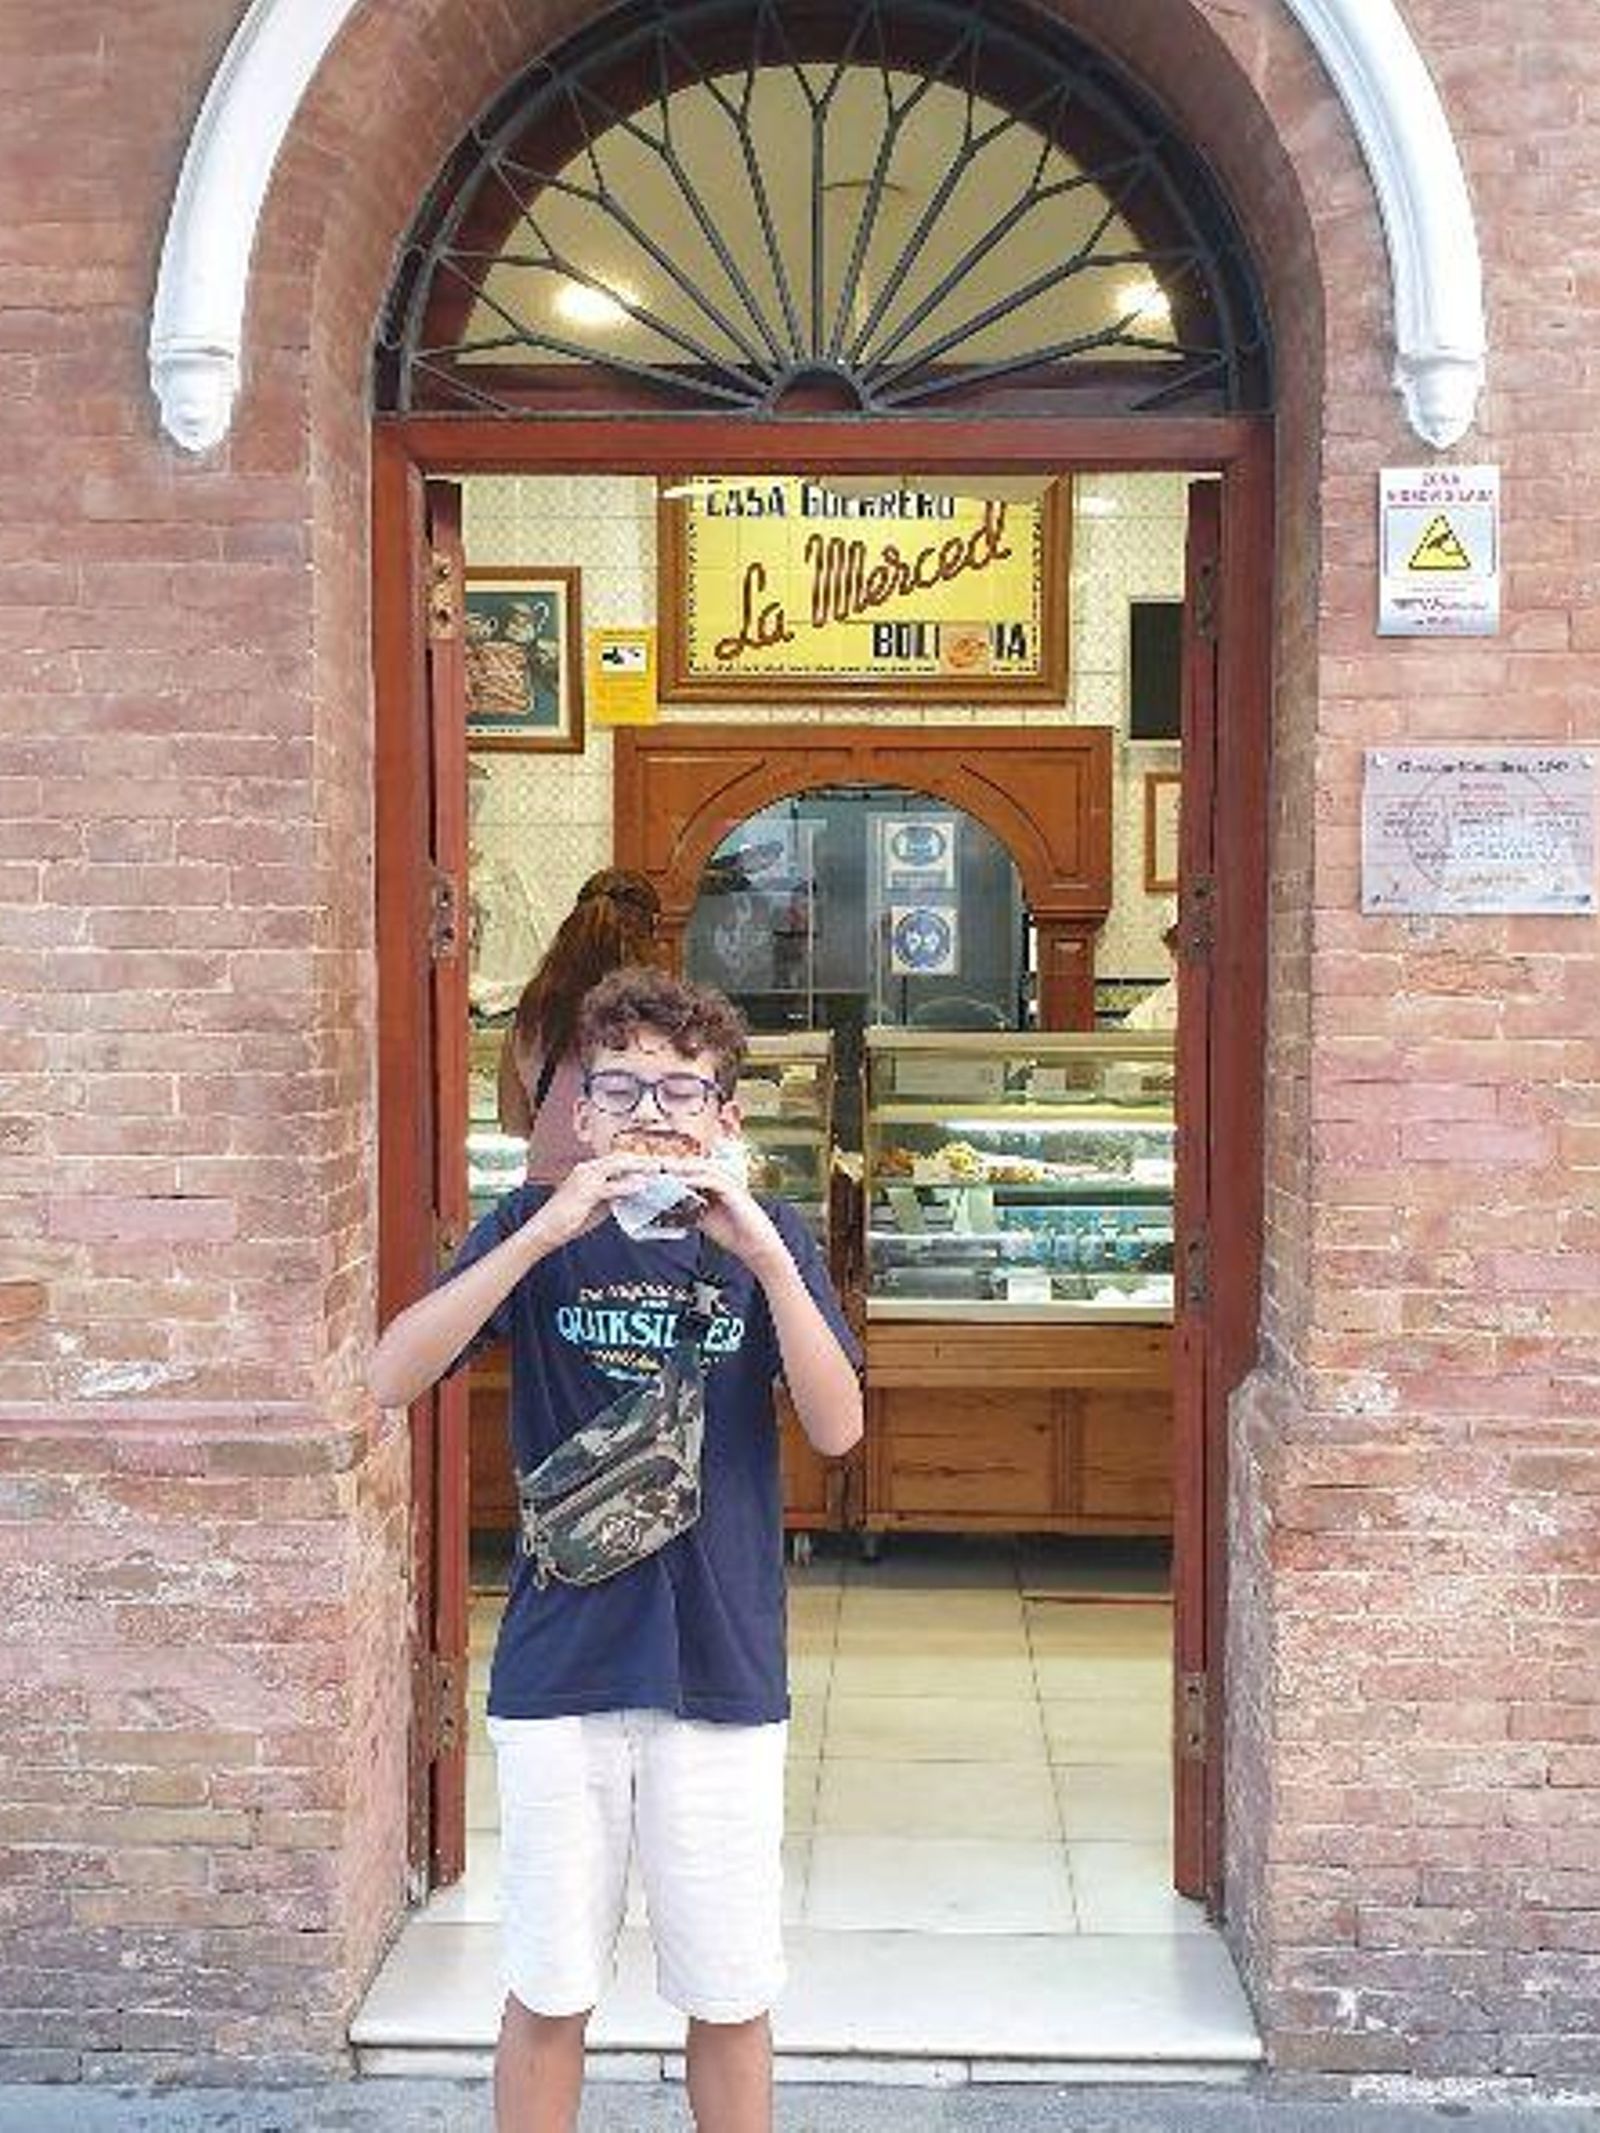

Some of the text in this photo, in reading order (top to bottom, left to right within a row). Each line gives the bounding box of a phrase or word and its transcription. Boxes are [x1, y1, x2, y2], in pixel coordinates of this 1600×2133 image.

[706, 485, 786, 518] CASA
[714, 498, 1013, 661] La Merced
[556, 1305, 746, 1353] QUIKSILER
